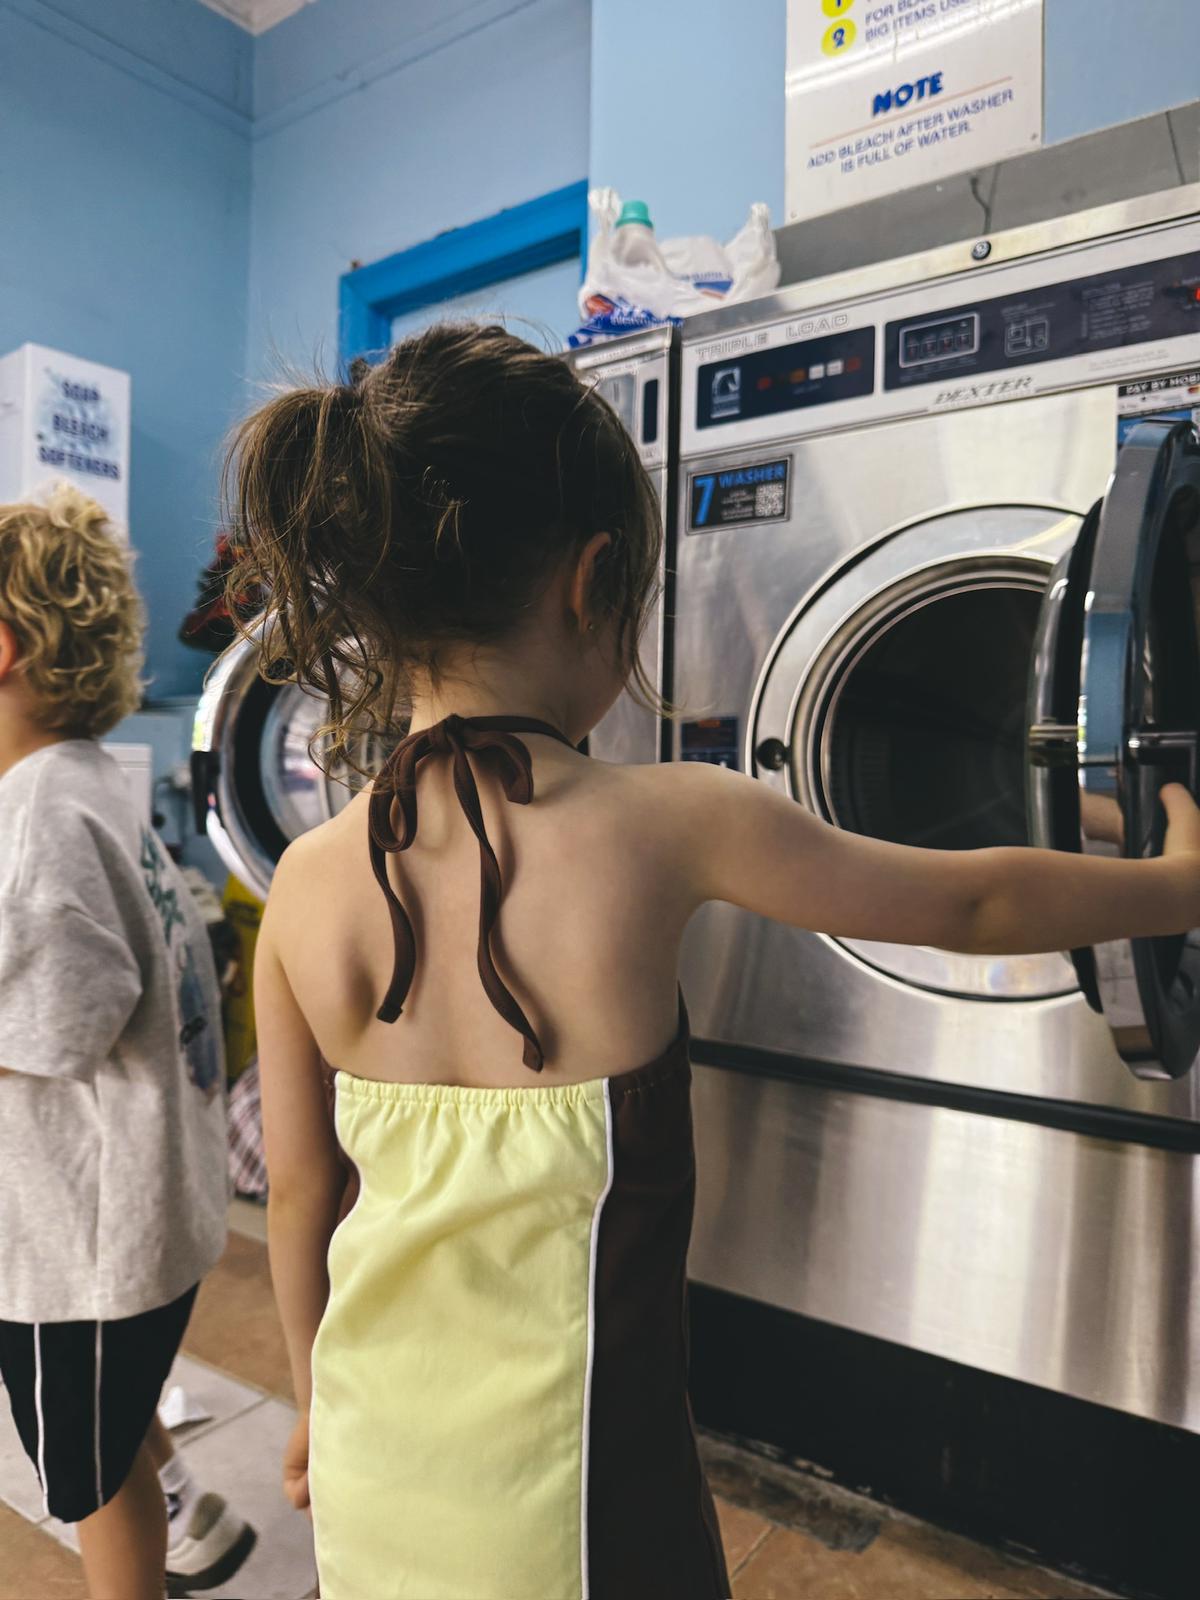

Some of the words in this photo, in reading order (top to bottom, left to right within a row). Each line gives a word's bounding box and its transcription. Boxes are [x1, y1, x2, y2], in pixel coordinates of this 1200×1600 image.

[865, 3, 894, 25] FOR
[865, 22, 889, 42] BIG
[892, 3, 936, 30] ITEMS
[940, 0, 969, 11] US
[872, 71, 944, 116] NOTE
[808, 151, 836, 169] ADD
[839, 129, 894, 159] BLEACH
[897, 113, 945, 138] AFTER
[948, 89, 1014, 121] WASHER
[841, 160, 855, 174] IS
[857, 148, 892, 168] FULL
[895, 138, 914, 155] OF
[696, 332, 769, 361] TRIPLE
[786, 314, 848, 340] LOAD
[62, 380, 101, 402] SOAP
[934, 376, 1034, 404] DEXTER
[1126, 384, 1148, 395] PAY
[1151, 380, 1169, 392] BY
[53, 413, 110, 441] BLEACH
[39, 446, 120, 480] SOFTENERS
[694, 475, 716, 526] 7
[719, 462, 786, 488] WASHER
